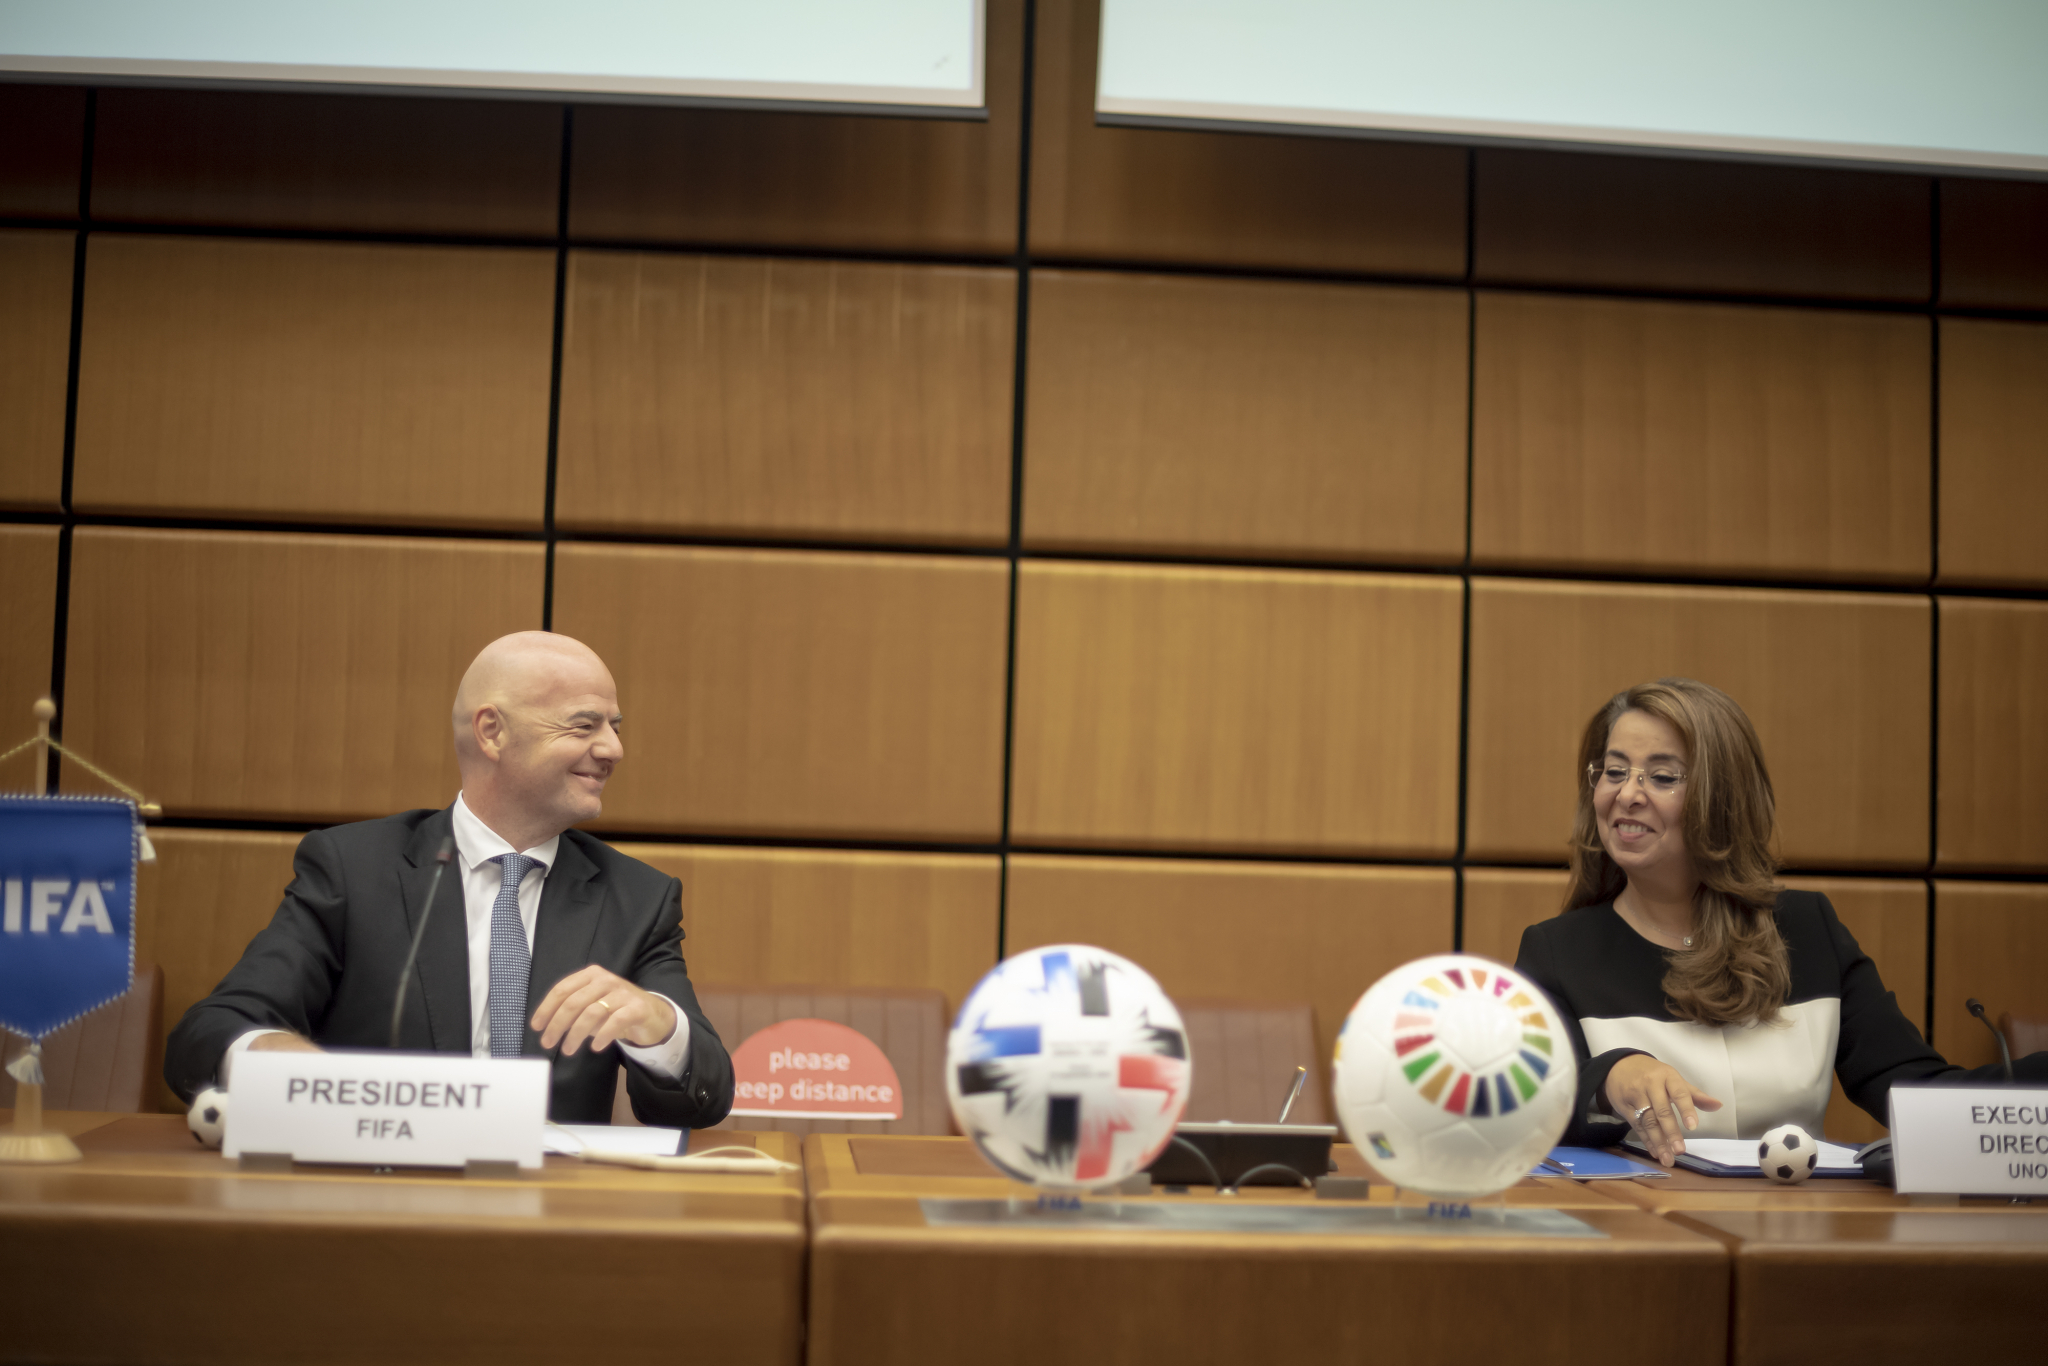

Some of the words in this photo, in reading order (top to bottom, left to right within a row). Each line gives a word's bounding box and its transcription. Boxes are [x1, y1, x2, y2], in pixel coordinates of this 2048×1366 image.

[0, 879, 115, 934] IFA
[768, 1046, 851, 1075] please
[286, 1077, 490, 1108] PRESIDENT
[789, 1078, 894, 1104] distance
[1971, 1105, 2048, 1125] EXECU
[356, 1119, 414, 1140] FIFA
[1980, 1134, 2048, 1155] DIREC
[2008, 1163, 2048, 1179] UNO
[1427, 1201, 1472, 1219] FIFA
